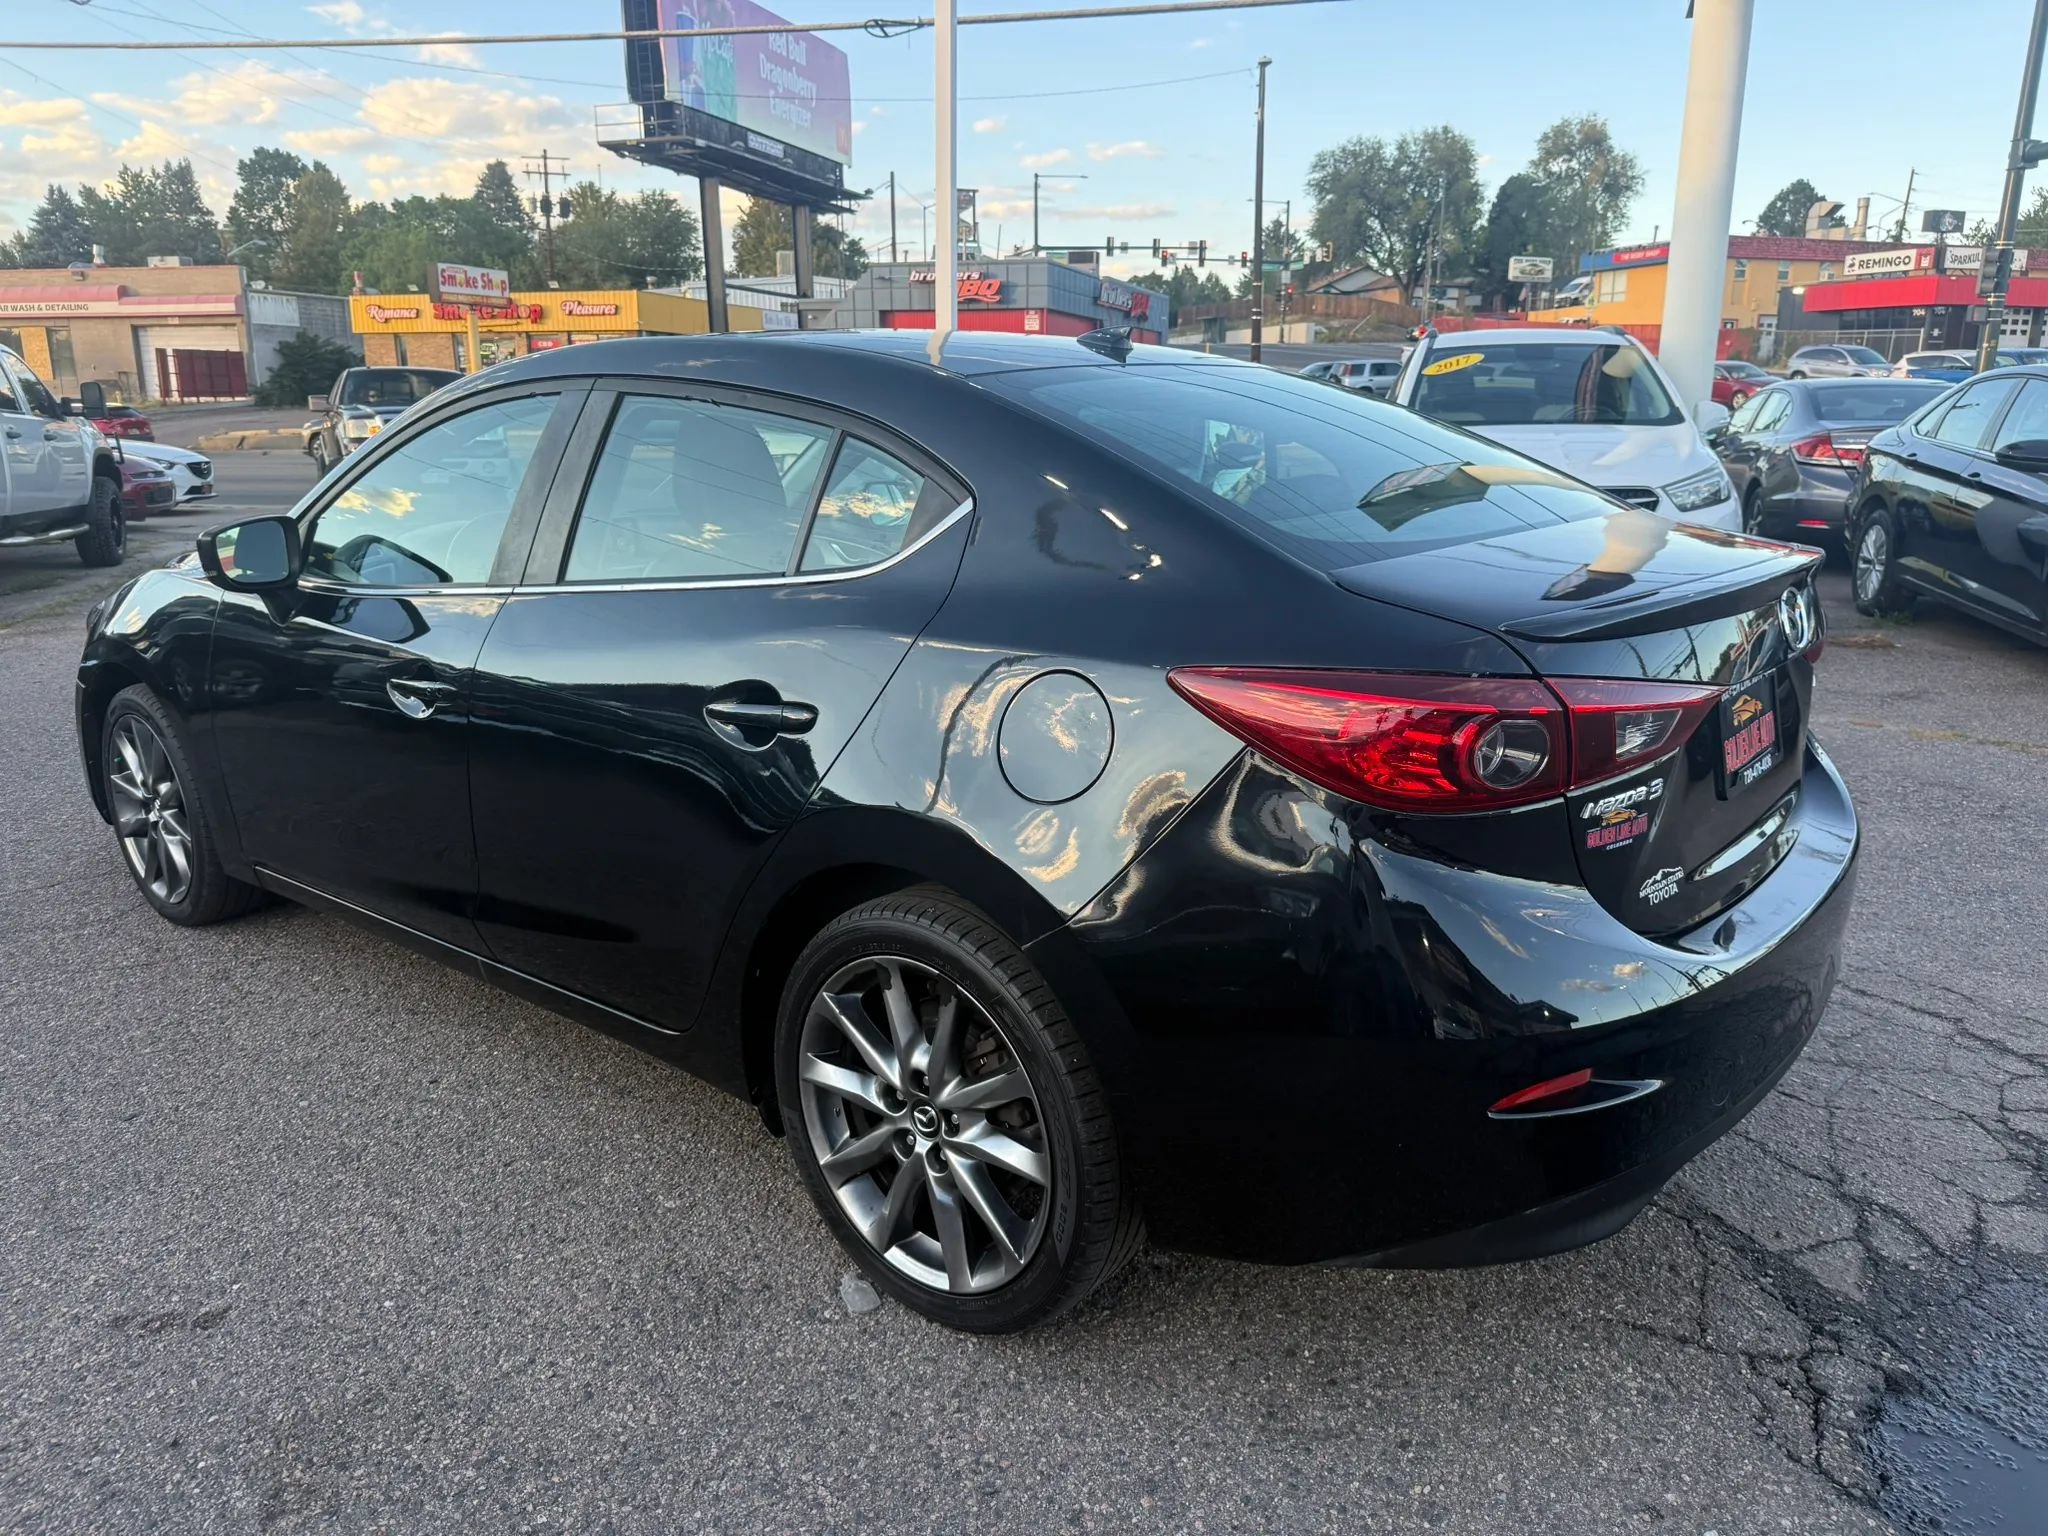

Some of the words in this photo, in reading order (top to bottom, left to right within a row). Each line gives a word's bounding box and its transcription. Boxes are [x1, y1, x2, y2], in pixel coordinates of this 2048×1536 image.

[768, 32, 787, 57] Red
[788, 36, 808, 66] Bull
[759, 53, 817, 108] Dragonberry
[769, 89, 812, 129] Energizer
[1858, 255, 1911, 270] REMINGO
[440, 267, 479, 289] Smoke
[480, 271, 507, 296] Shop
[909, 270, 981, 281] broers
[957, 279, 1001, 298] BQ
[10, 304, 36, 313] WASH
[37, 304, 43, 312] &
[45, 303, 89, 312] DETAILING
[366, 304, 418, 323] Romance
[561, 301, 618, 316] Pleasures
[1435, 355, 1471, 372] 2017
[1586, 825, 1616, 849] GOLDEN
[1616, 822, 1632, 841] LINE
[1631, 815, 1648, 837] AUTO
[1639, 879, 1668, 898] MOUNTAIN
[1667, 870, 1685, 884] STATES
[1648, 882, 1679, 905] TOYOTA
